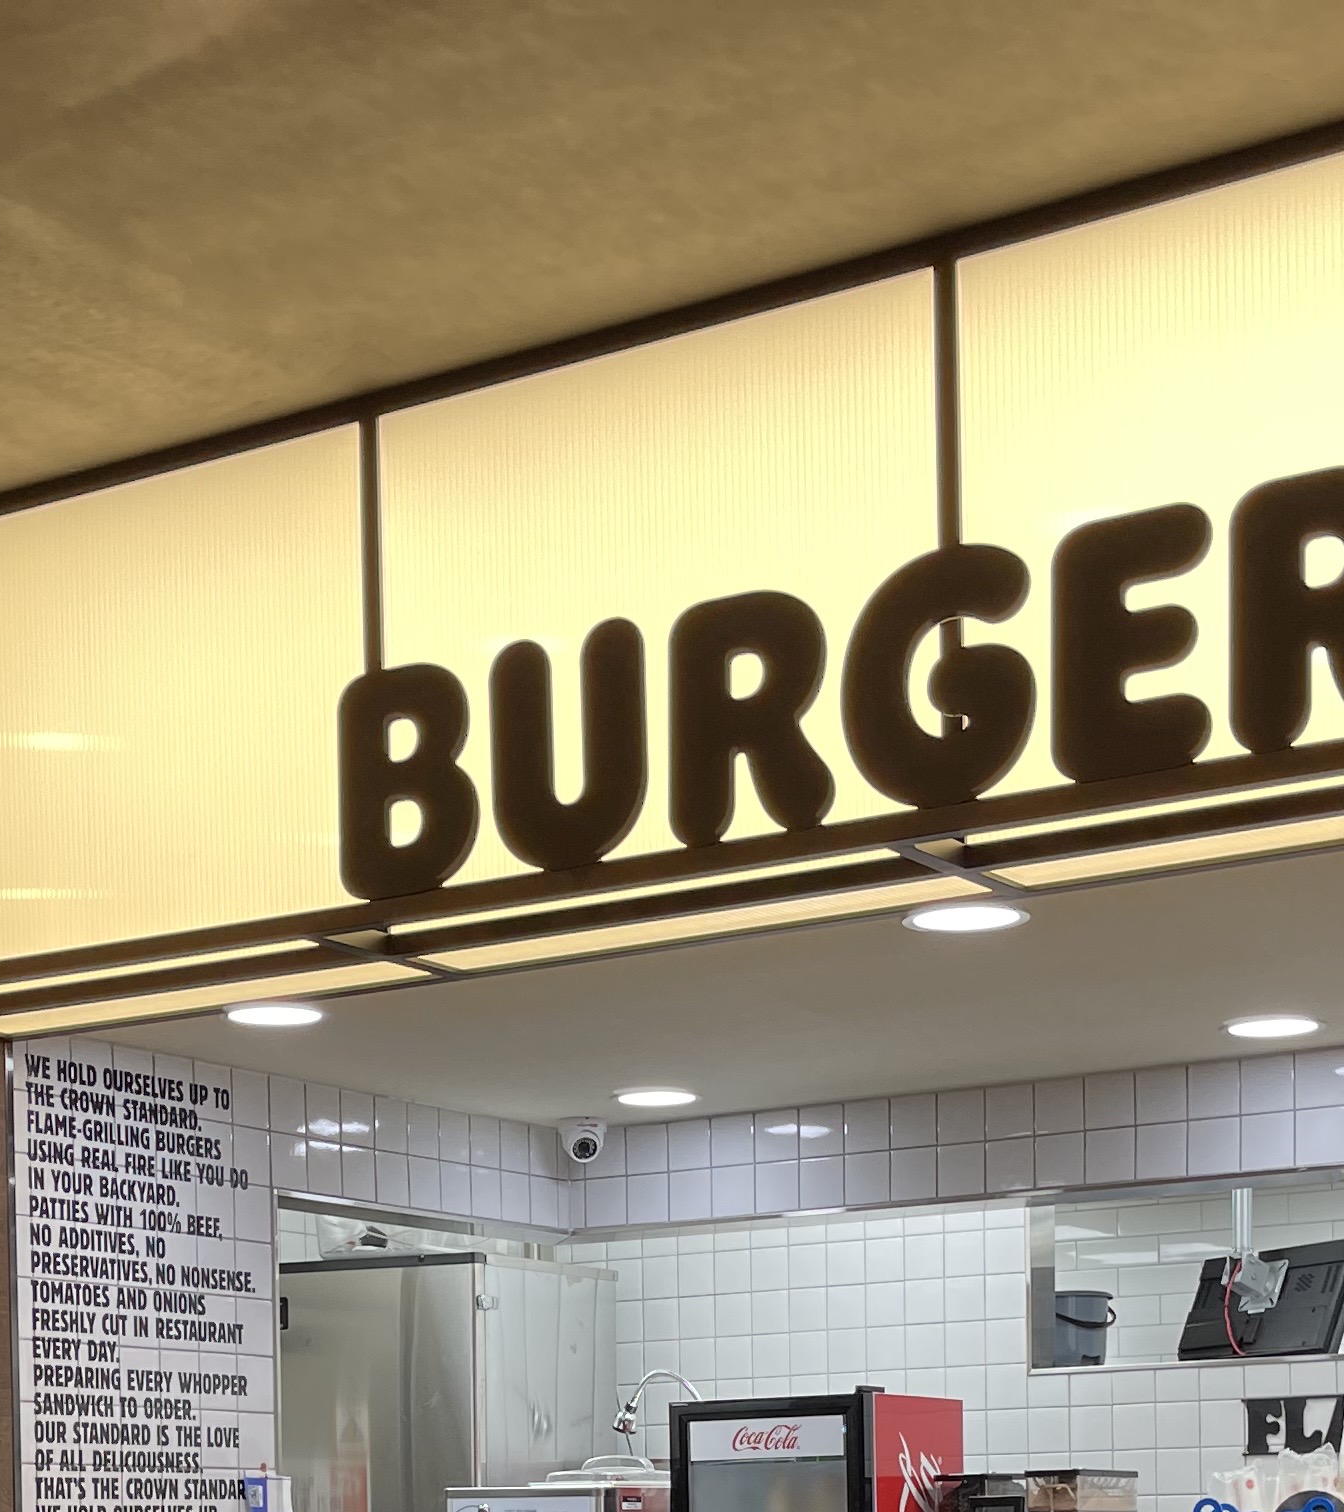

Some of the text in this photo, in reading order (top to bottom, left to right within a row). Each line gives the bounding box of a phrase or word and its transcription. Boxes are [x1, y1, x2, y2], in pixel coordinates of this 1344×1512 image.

[25, 1053, 229, 1110] WE HOLD OURSELVES UP TO
[26, 1082, 202, 1132] THE CROWN STANDARD.
[27, 1111, 221, 1160] FLAME-GRILLING BURGERS
[28, 1139, 248, 1190] USING REAL FIRE LIKE YOU DO
[28, 1167, 179, 1207] IN YOUR BACKYARD.
[29, 1196, 222, 1241] PATTIES WITH 100% BEEF,
[30, 1223, 165, 1258] NO ADDITIVES, NO
[31, 1252, 255, 1293] PRESERVATIVES, NO NONSENSE.
[31, 1280, 206, 1315] TOMATOES AND ONIONS
[32, 1308, 243, 1344] FRESHLY CUT IN RESTAURANT
[33, 1337, 119, 1362] EVERY DAY.
[33, 1364, 248, 1396] PREPARING EVERY WHOPPER
[34, 1393, 196, 1420] SANDWICH TO ORDER.
[34, 1421, 239, 1448] OUR STANDARD IS THE LOVE
[732, 1424, 802, 1452] Coca-Cola
[35, 1450, 203, 1473] OF ALL DELICIOUSNESS.
[35, 1478, 245, 1501] THAT'S THE CROWN STANDAR
